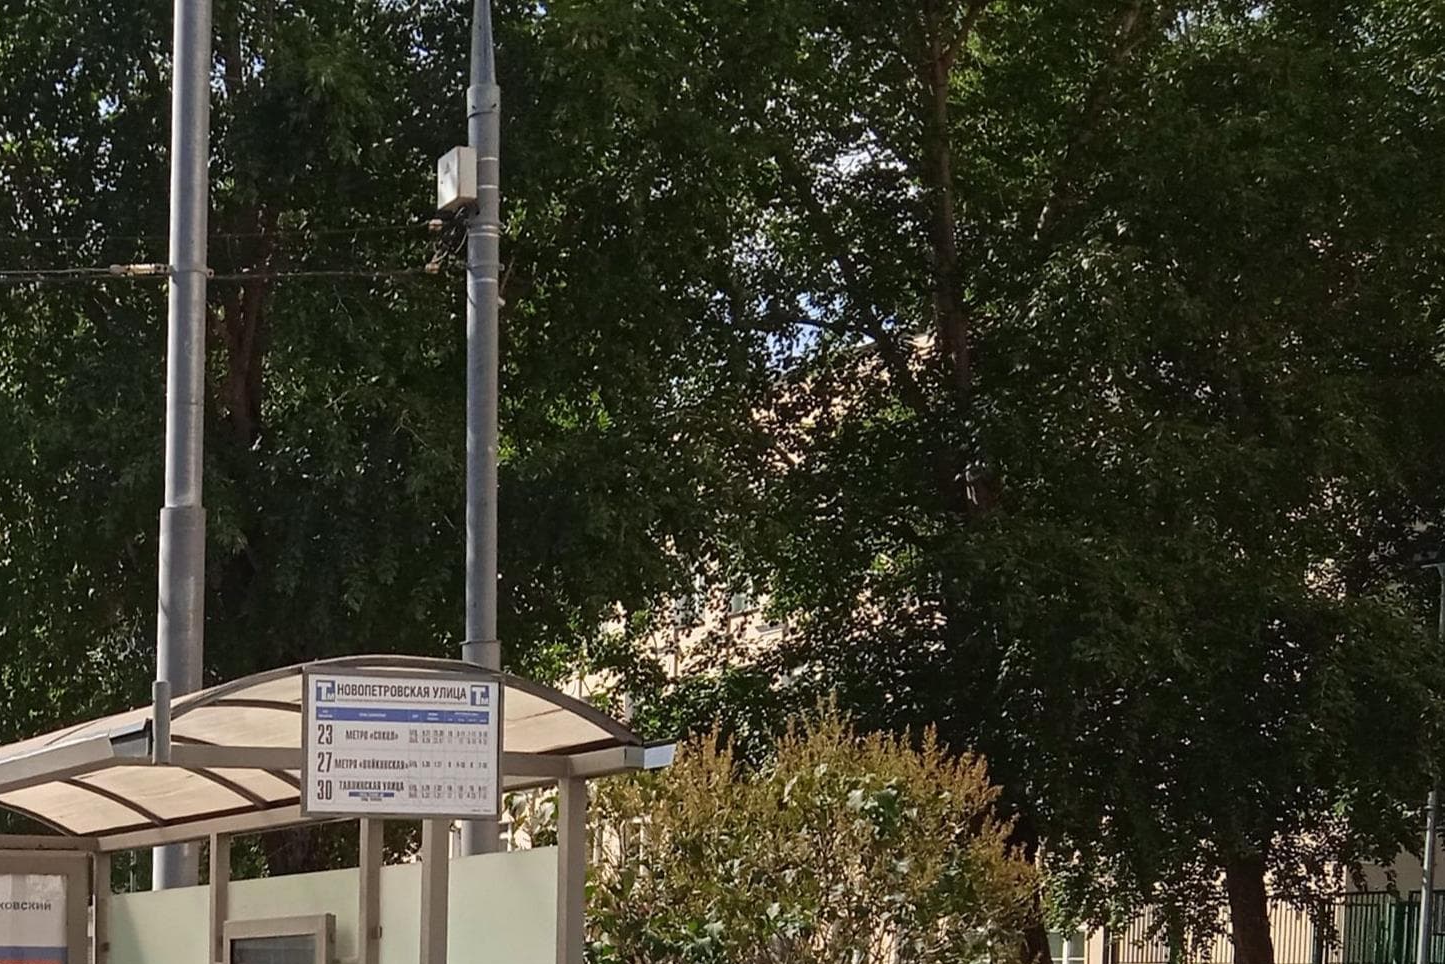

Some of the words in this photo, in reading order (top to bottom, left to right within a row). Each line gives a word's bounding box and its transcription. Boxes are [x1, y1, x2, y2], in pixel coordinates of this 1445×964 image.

[337, 683, 430, 698] НОВОПЕТРОВСКАЯ
[432, 686, 467, 701] УЛИЦА
[318, 724, 333, 745] 23
[318, 752, 332, 773] 27
[317, 780, 332, 800] 30
